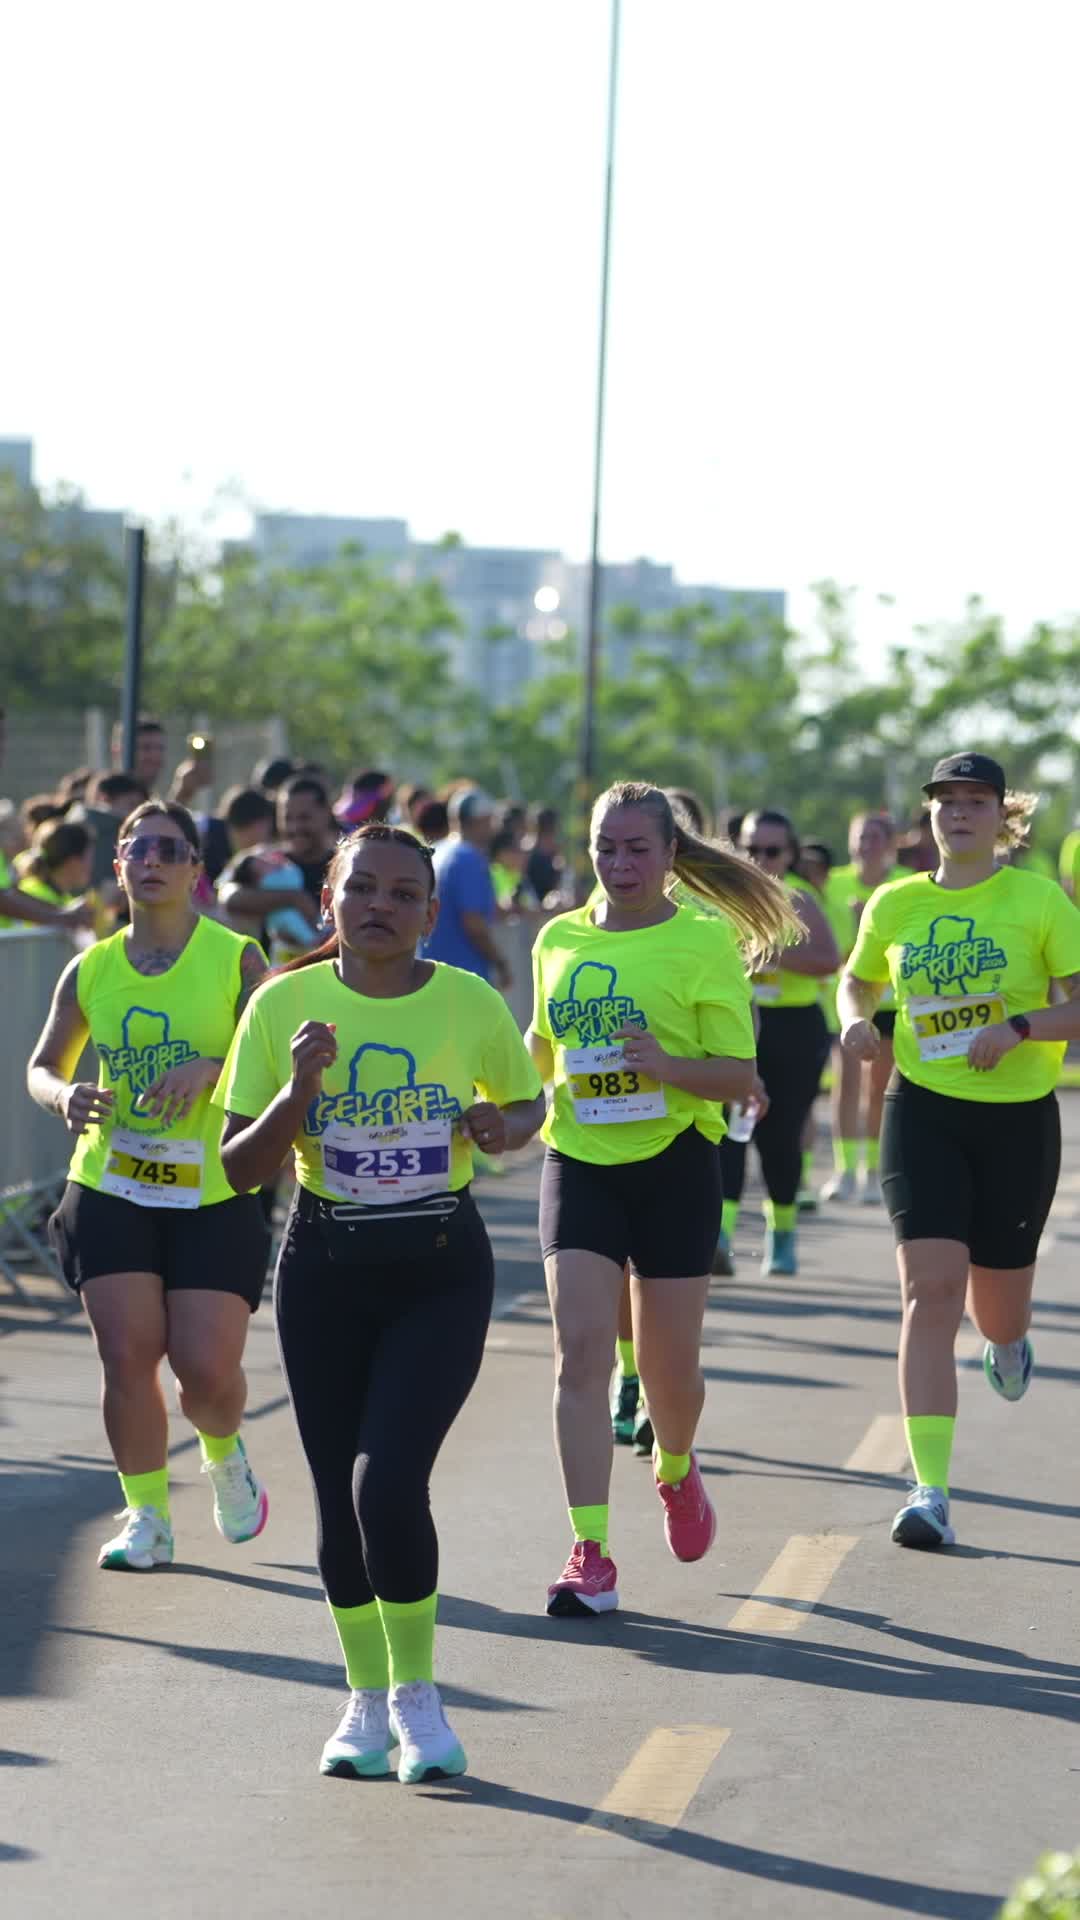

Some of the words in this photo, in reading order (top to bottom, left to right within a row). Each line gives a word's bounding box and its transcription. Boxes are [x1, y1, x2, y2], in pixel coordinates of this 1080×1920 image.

[928, 956, 979, 984] RUN
[930, 1004, 991, 1034] 1099
[589, 1071, 640, 1097] 983
[131, 1158, 178, 1185] 745
[355, 1150, 422, 1177] 253
